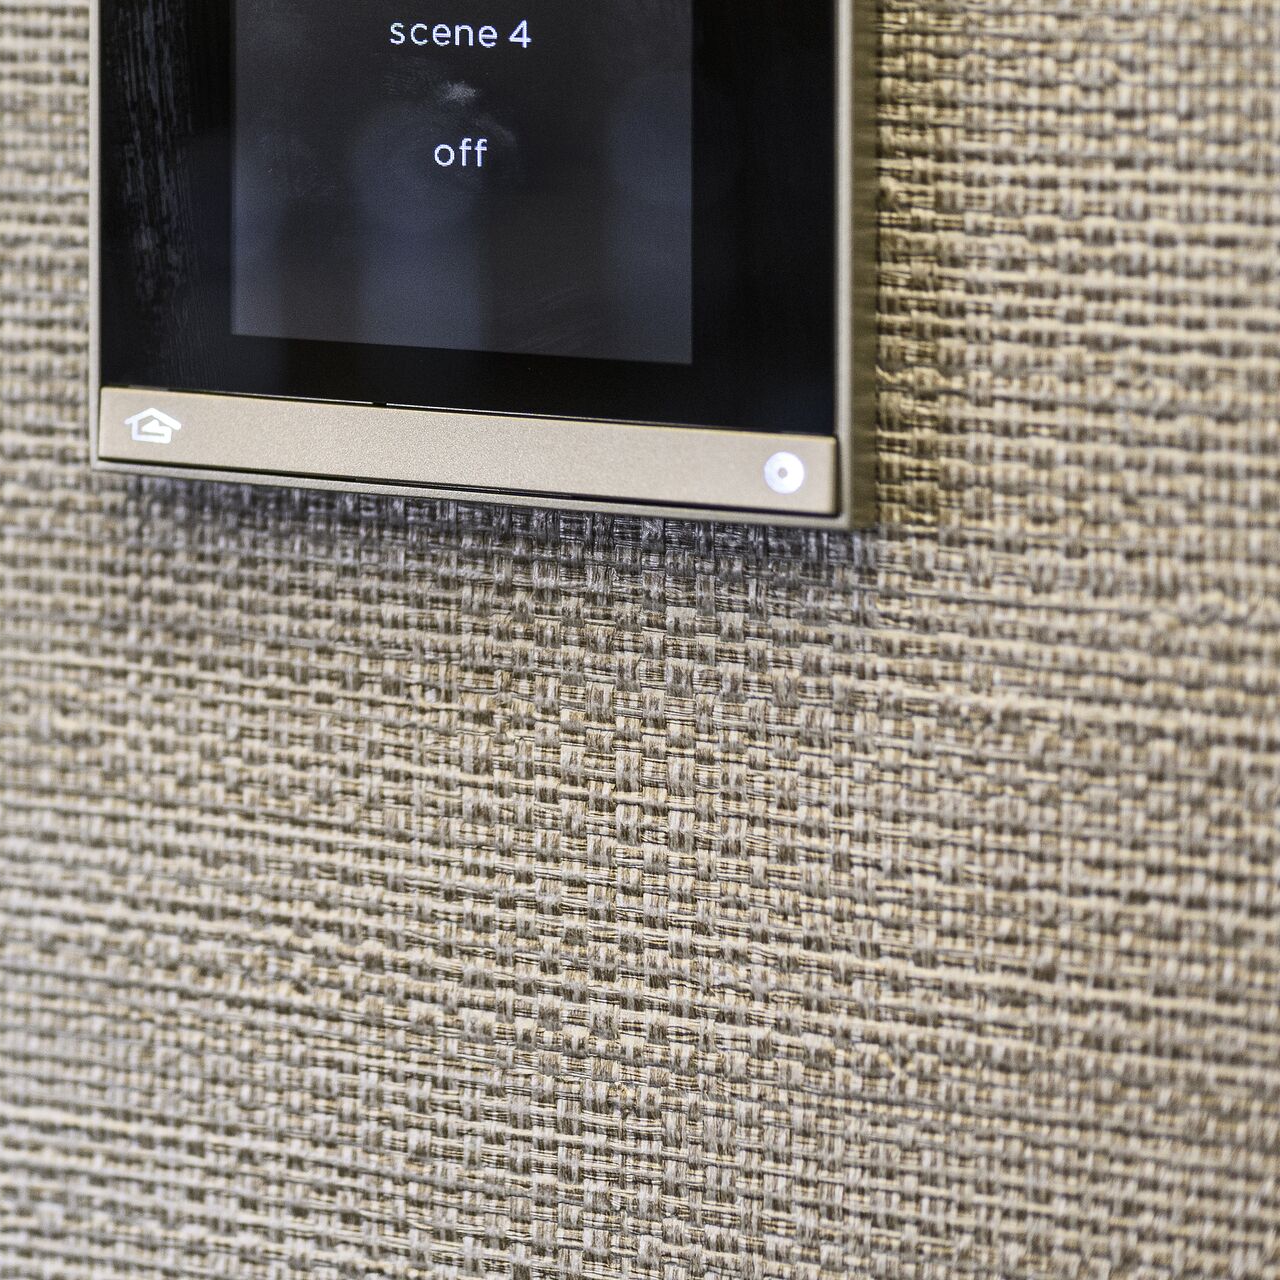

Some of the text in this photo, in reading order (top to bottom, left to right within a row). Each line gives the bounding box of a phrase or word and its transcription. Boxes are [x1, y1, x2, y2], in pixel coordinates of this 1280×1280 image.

[389, 19, 532, 49] scene 4
[433, 138, 488, 168] off
